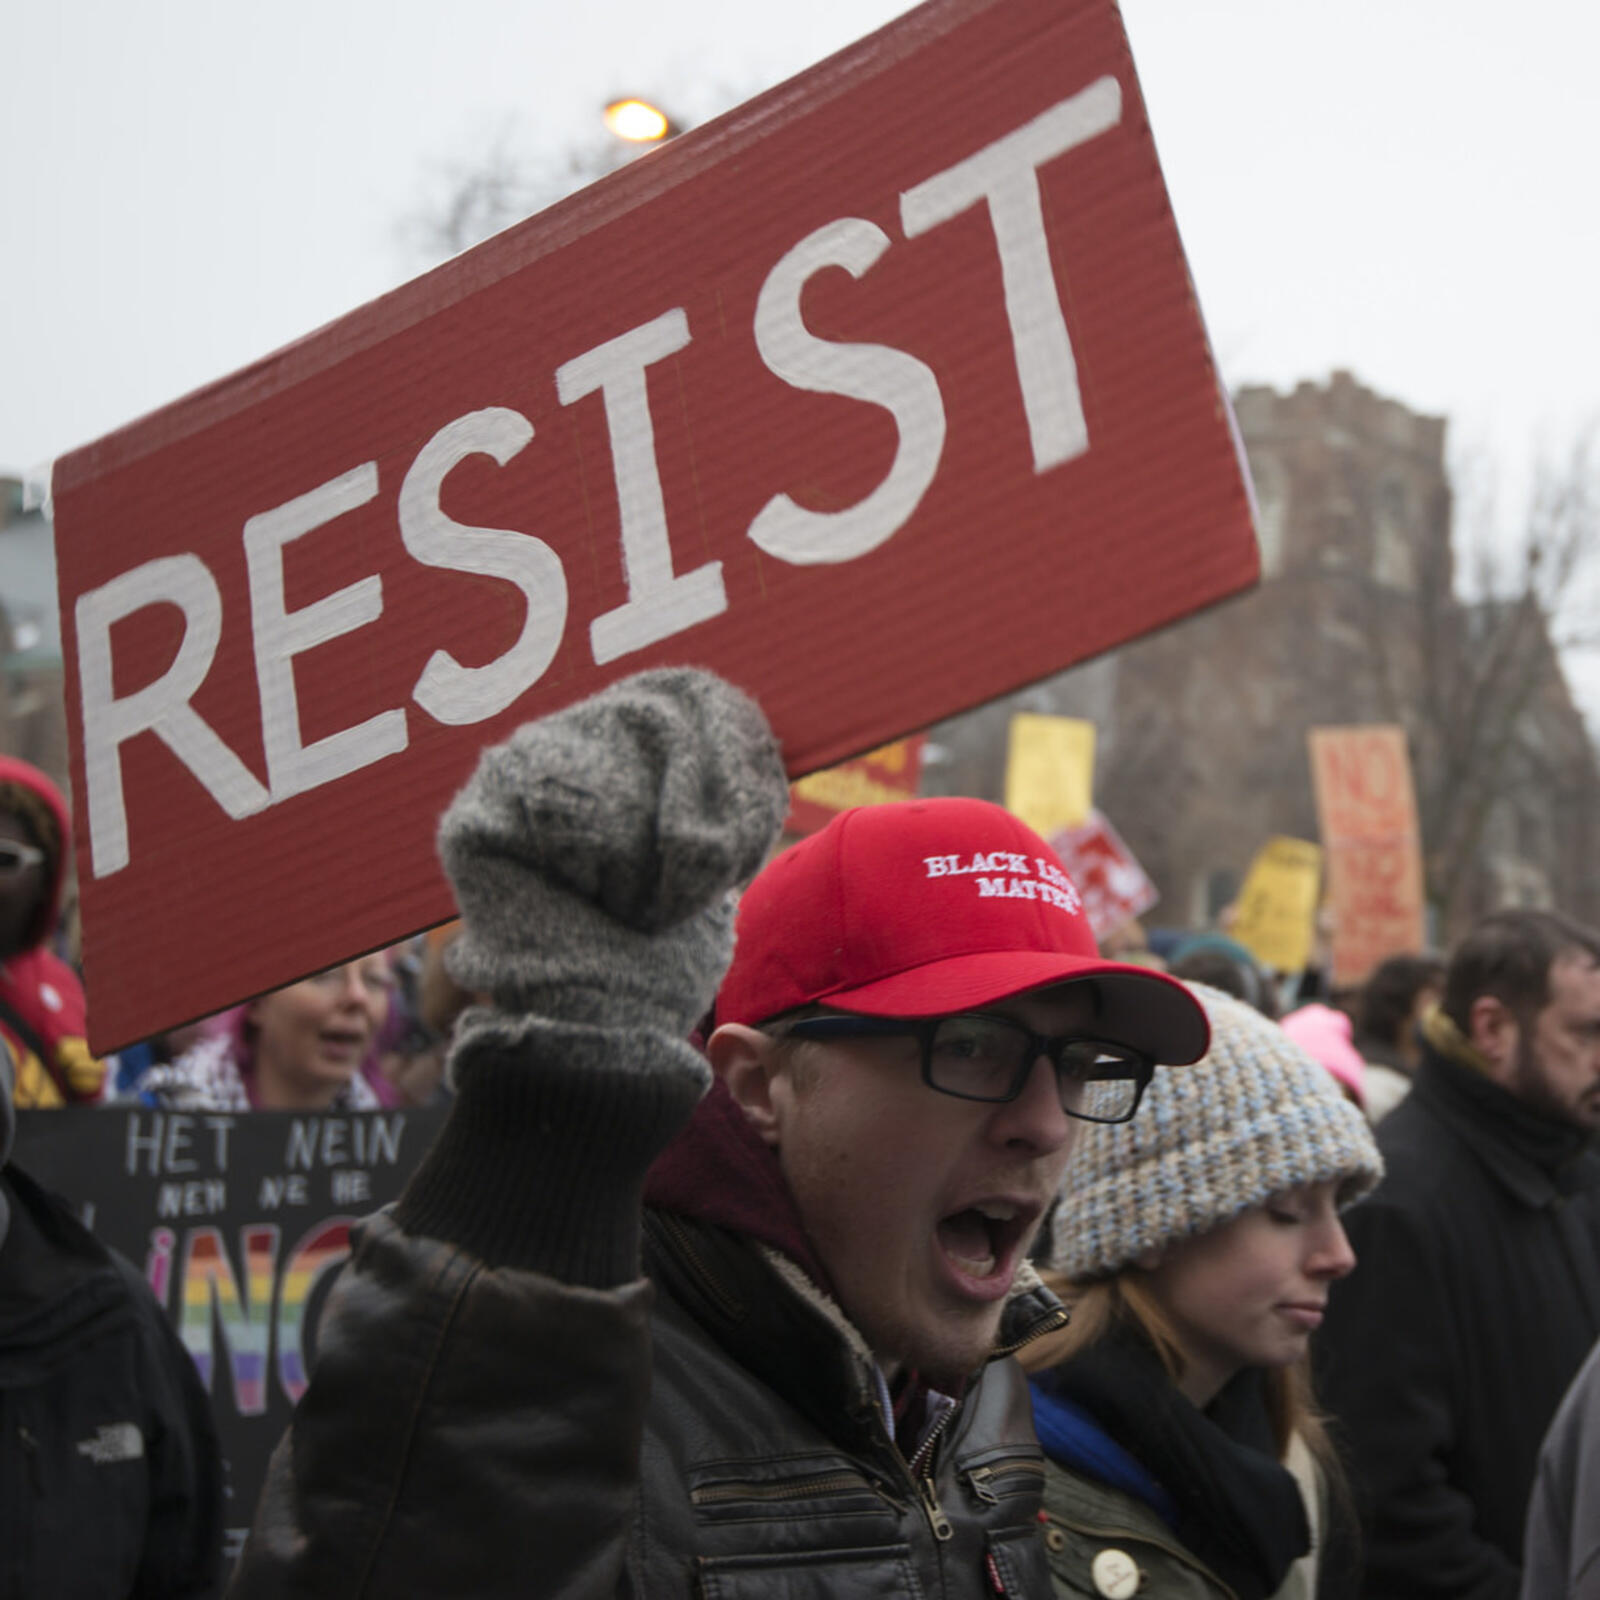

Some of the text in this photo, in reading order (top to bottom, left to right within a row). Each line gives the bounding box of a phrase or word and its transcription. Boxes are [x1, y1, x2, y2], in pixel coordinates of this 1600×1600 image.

[75, 75, 1122, 879] RESIST
[923, 851, 1030, 878] BLACK
[125, 1112, 405, 1176] HET NEIN
